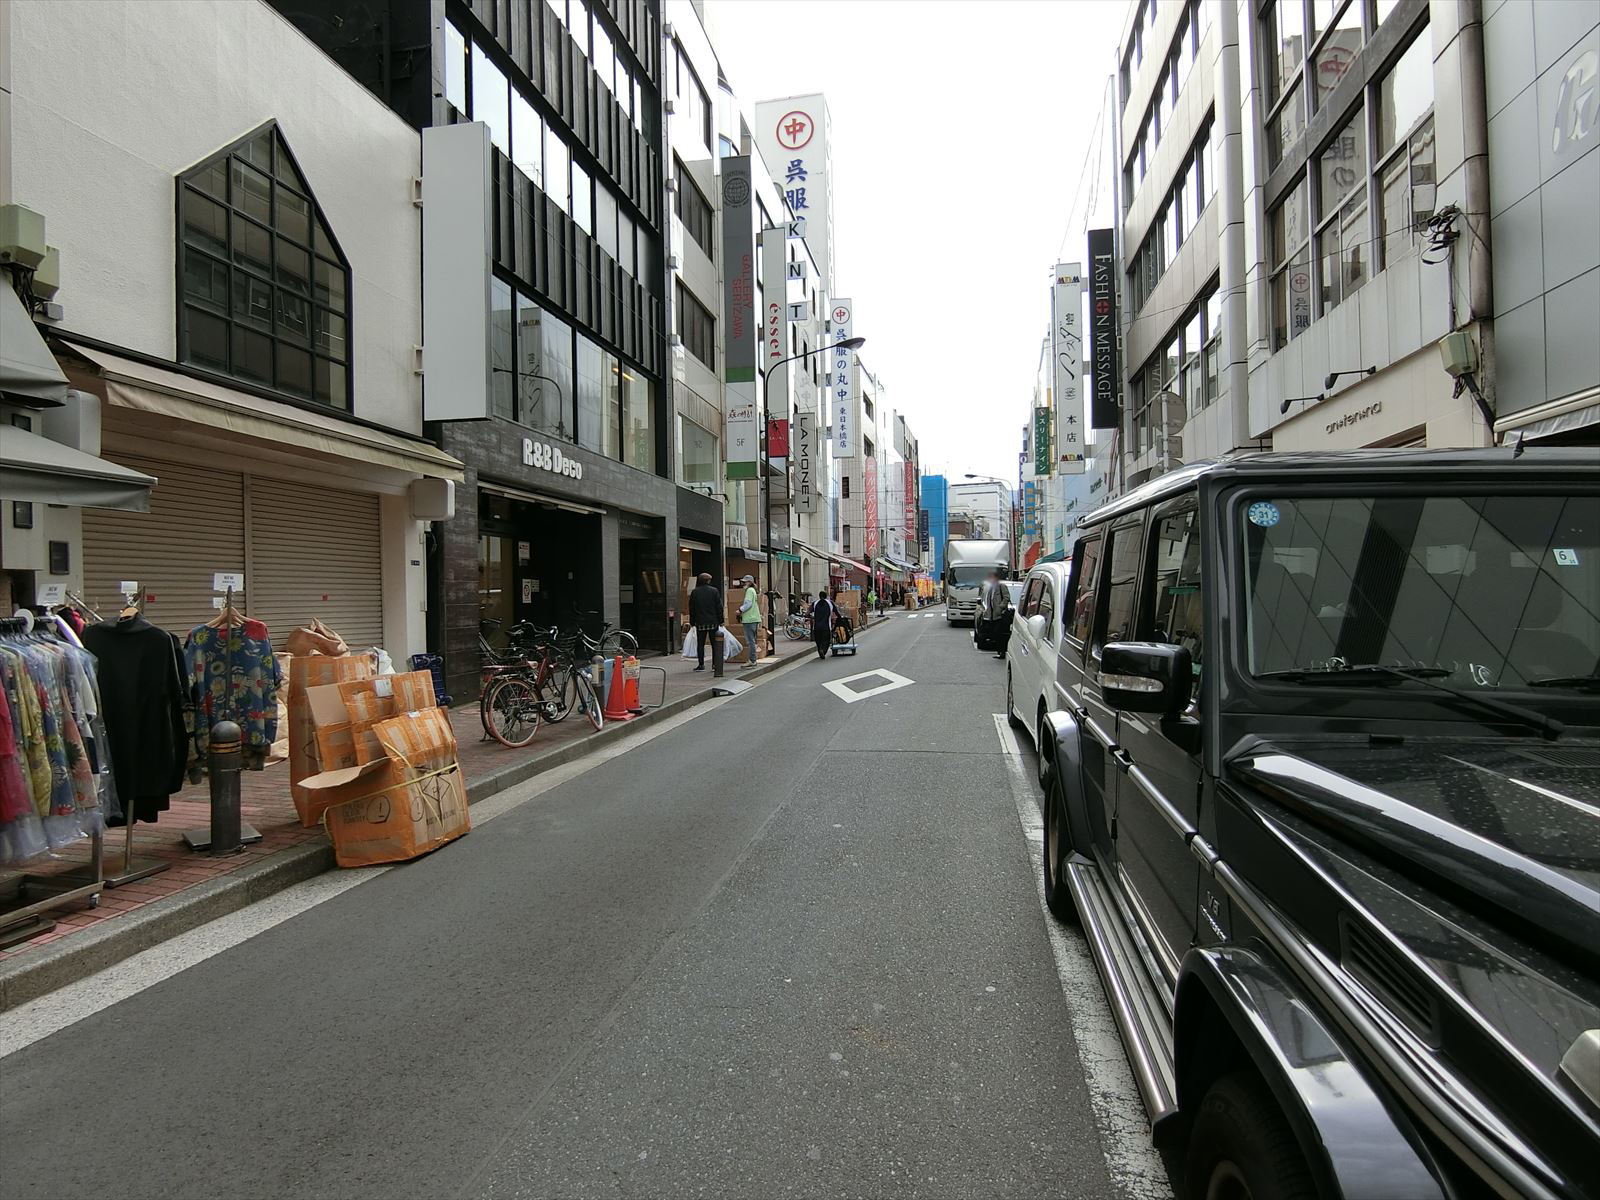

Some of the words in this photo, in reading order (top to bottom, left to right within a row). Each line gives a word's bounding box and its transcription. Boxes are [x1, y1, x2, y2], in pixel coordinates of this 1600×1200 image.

[785, 159, 809, 221] 呉服
[732, 278, 743, 339] SERIZAWA
[743, 255, 752, 309] GALLERY
[1095, 254, 1111, 326] FASHION
[1097, 333, 1110, 400] MESSAGE
[839, 407, 847, 448] 東日本橋店
[1066, 415, 1077, 443] 本店
[522, 438, 552, 471] R&B
[553, 447, 582, 480] Deco
[866, 477, 878, 551] MARUKAWA
[1558, 550, 1567, 560] 6
